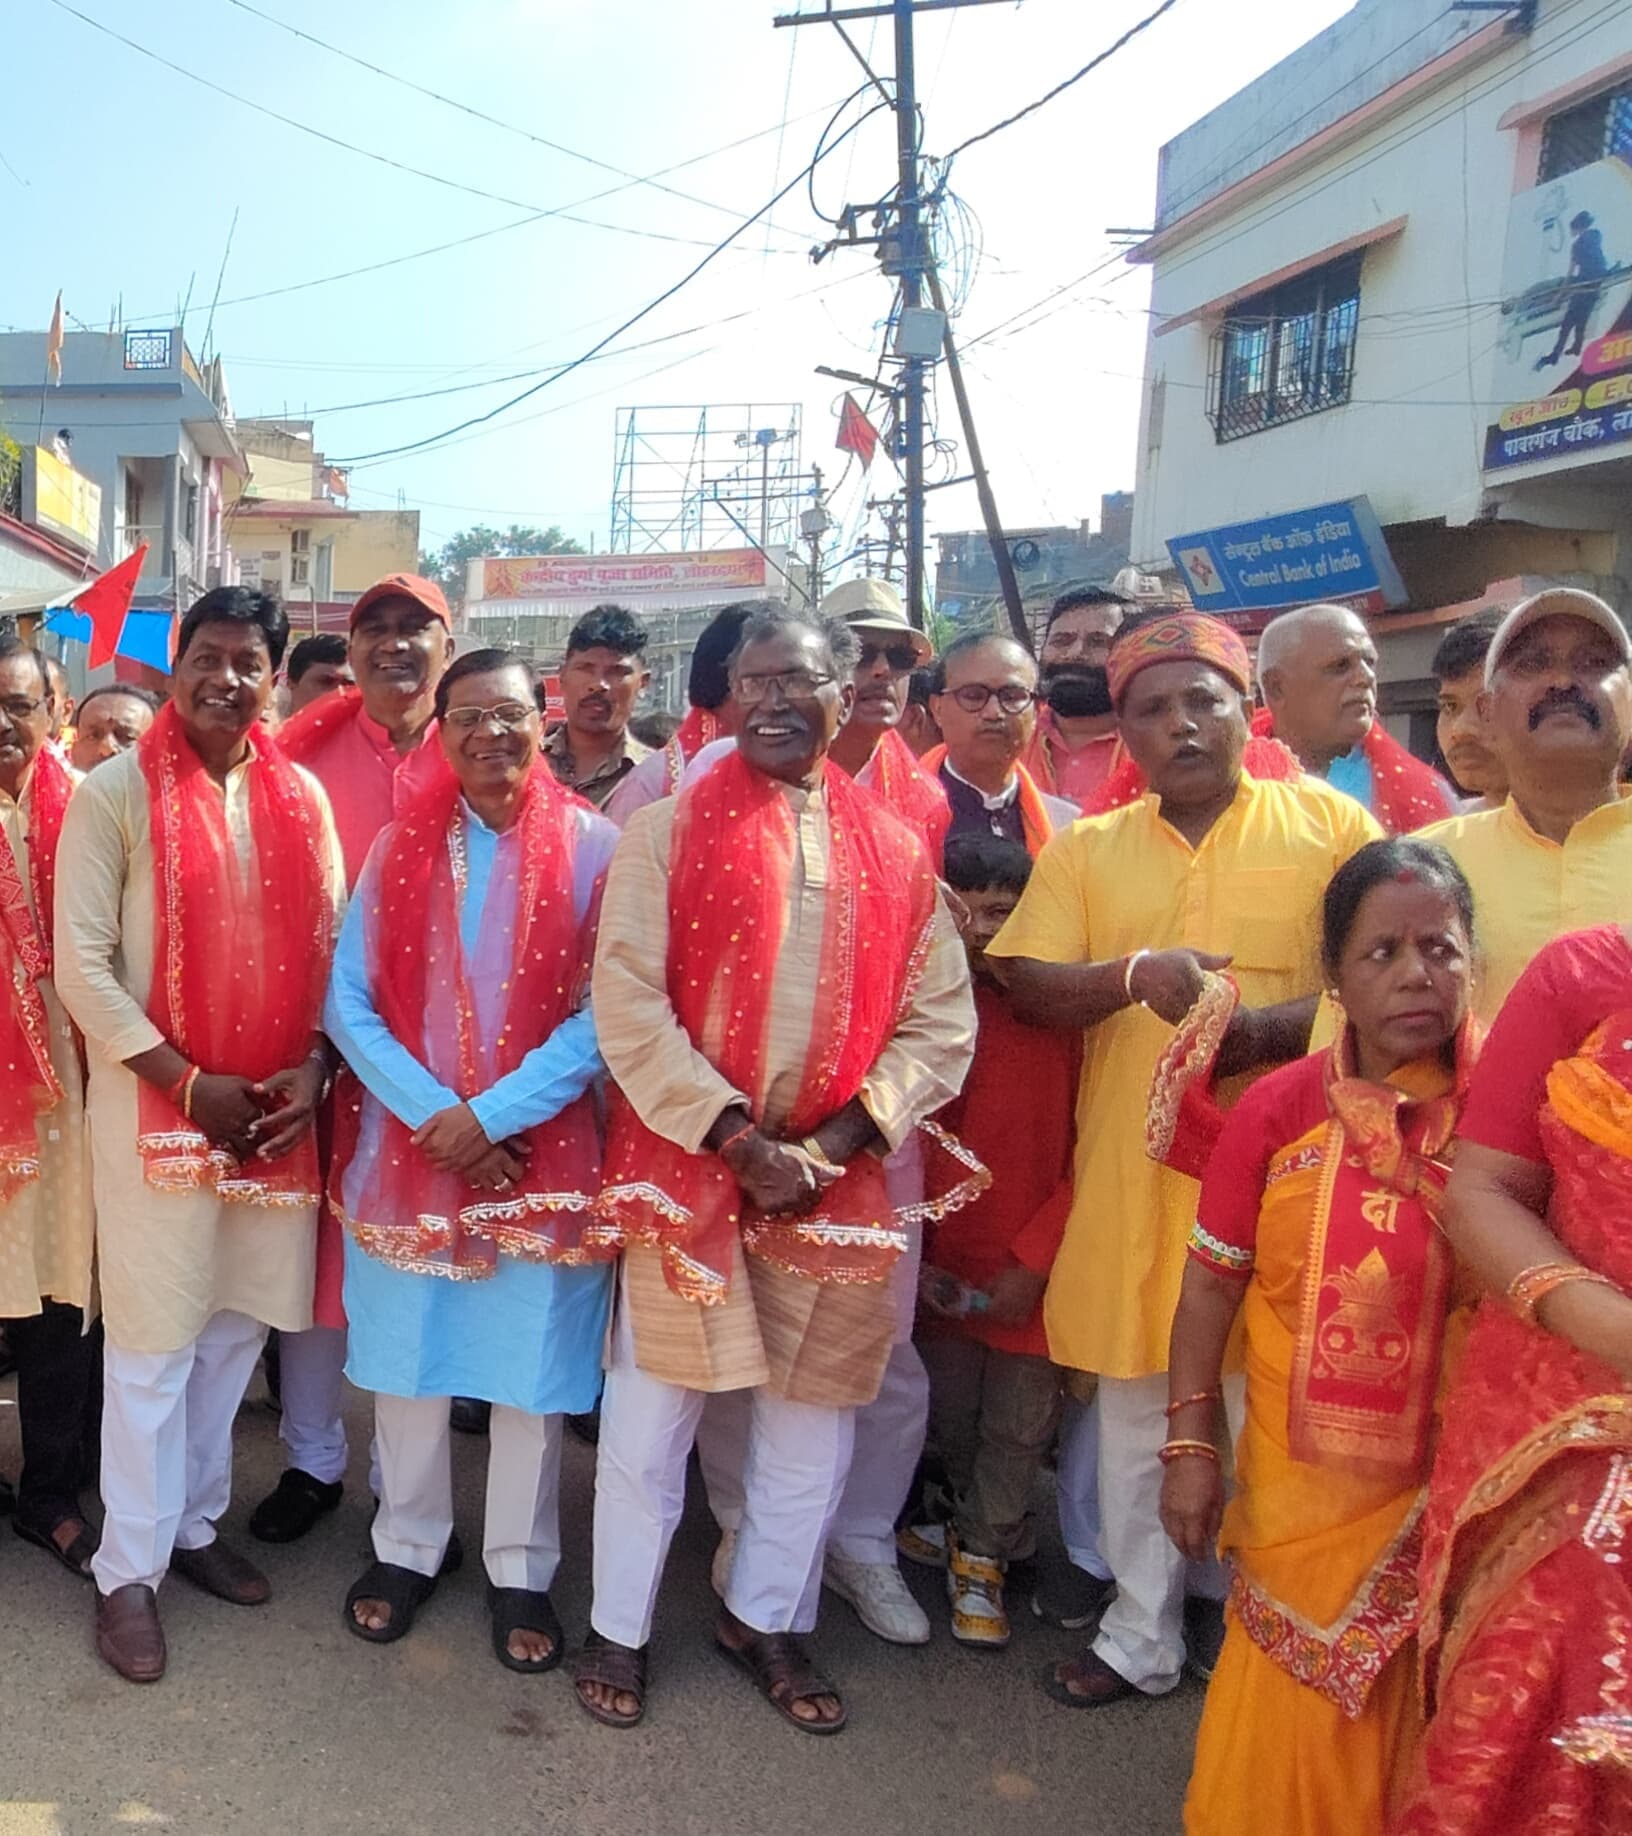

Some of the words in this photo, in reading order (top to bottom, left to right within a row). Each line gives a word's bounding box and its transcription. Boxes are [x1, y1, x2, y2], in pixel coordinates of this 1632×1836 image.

[1563, 416, 1605, 445] चौक,
[1262, 532, 1285, 552] बैंक
[1238, 568, 1282, 587] Central
[1282, 557, 1315, 582] Bank
[1315, 556, 1328, 577] of
[1329, 548, 1361, 572] India
